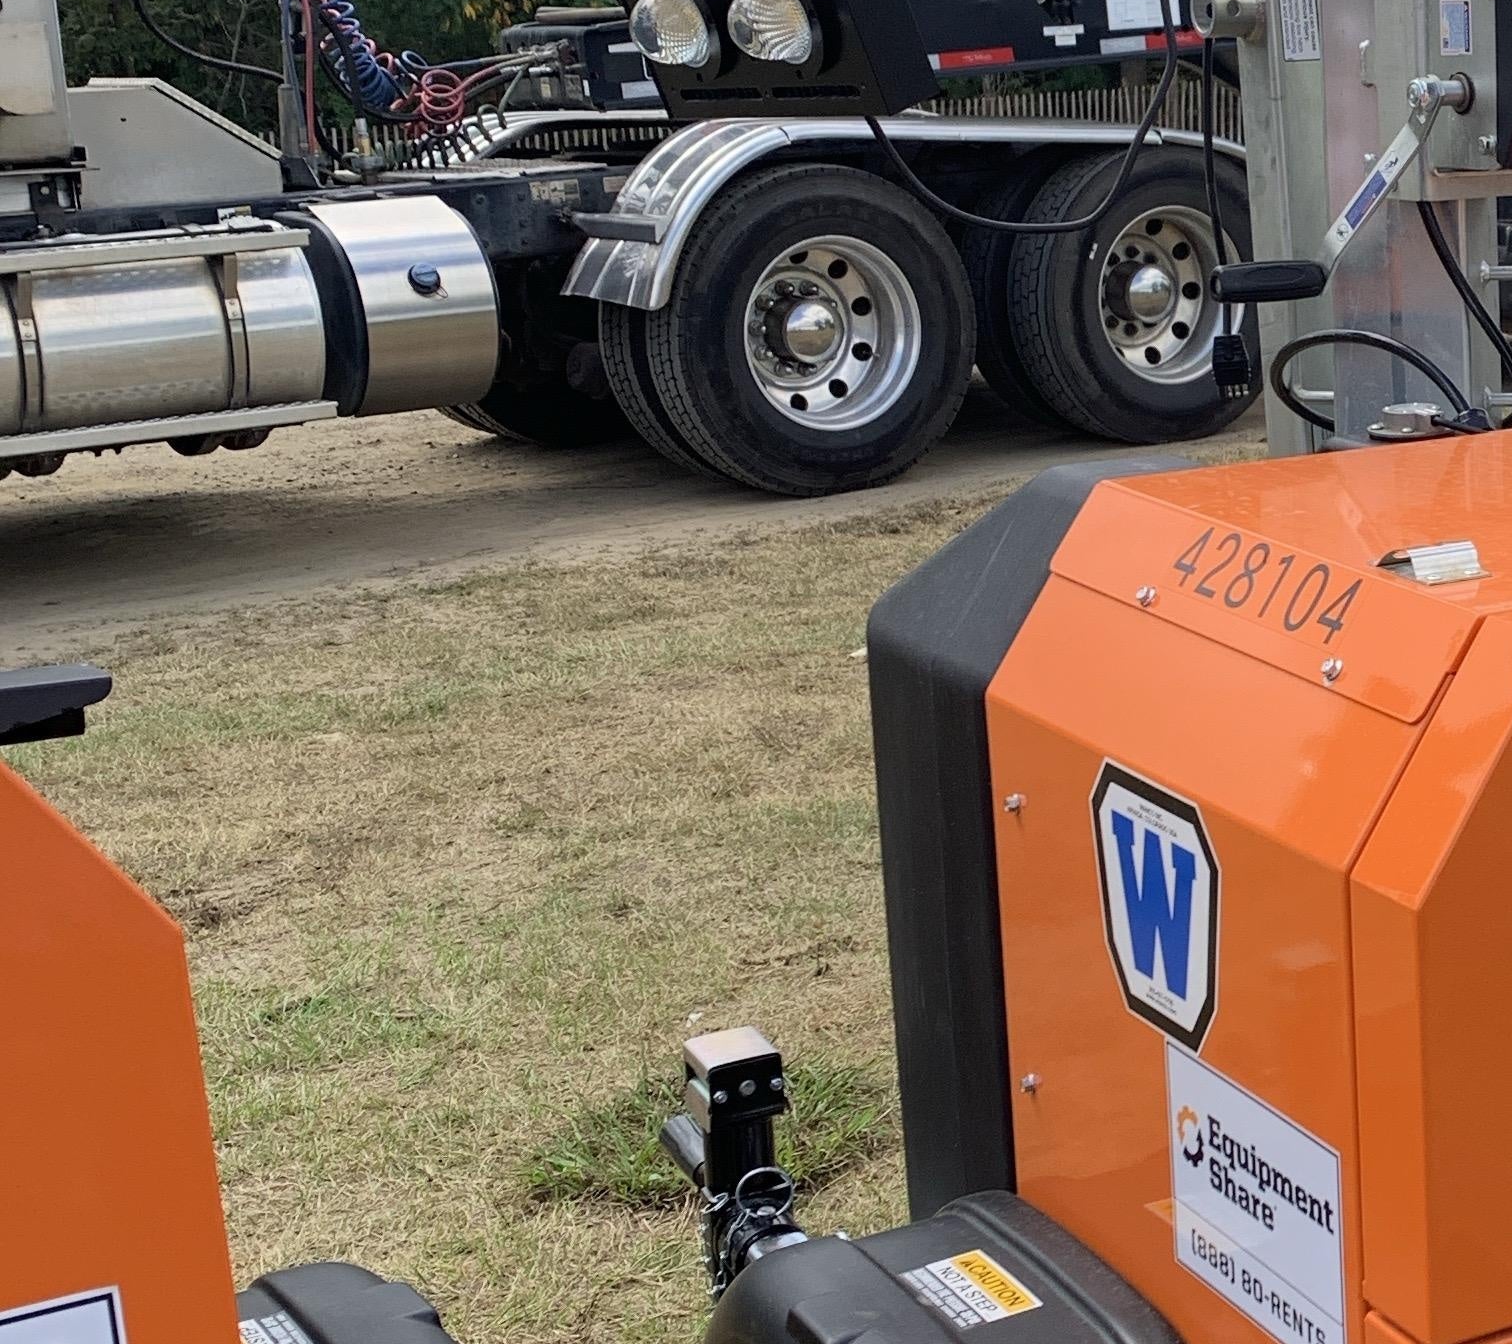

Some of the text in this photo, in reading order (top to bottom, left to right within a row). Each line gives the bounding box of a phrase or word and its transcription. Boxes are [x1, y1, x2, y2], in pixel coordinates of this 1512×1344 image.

[1173, 527, 1364, 644] 428104
[1111, 809, 1196, 1000] W
[1207, 1114, 1335, 1234] Equipment
[1209, 1157, 1275, 1231] Share
[939, 1266, 967, 1283] NOT
[965, 1290, 998, 1312] STEP
[968, 1264, 1025, 1307] CAUTION
[1191, 1228, 1236, 1284] (888)
